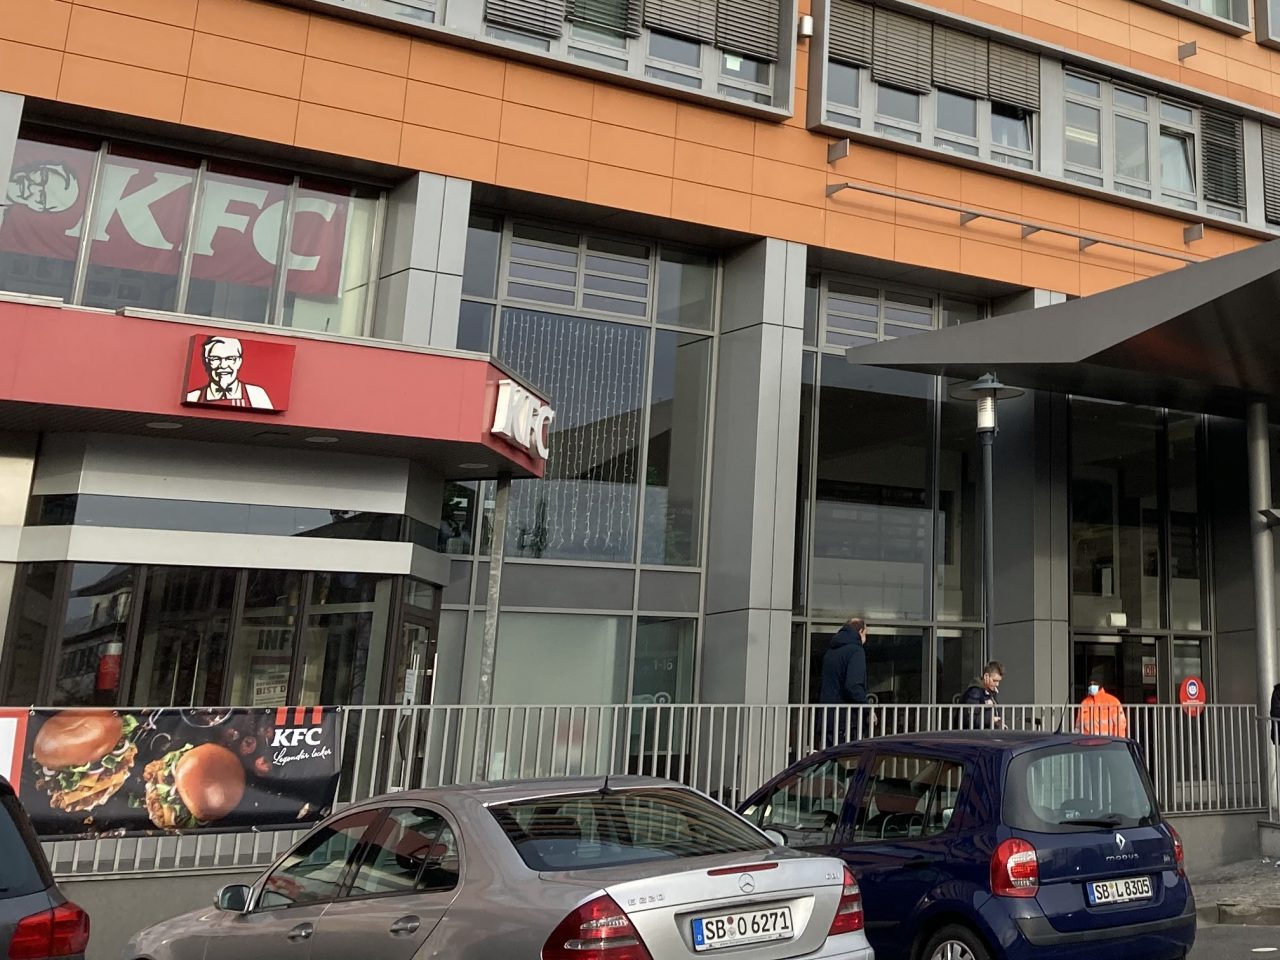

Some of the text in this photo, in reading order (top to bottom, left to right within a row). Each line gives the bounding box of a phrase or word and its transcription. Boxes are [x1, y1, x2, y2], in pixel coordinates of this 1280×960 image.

[65, 163, 337, 272] KFC
[491, 379, 556, 460] KFC
[270, 728, 323, 747] KFC
[1094, 879, 1150, 900] SB L 8305
[705, 911, 790, 940] SB O 6271
